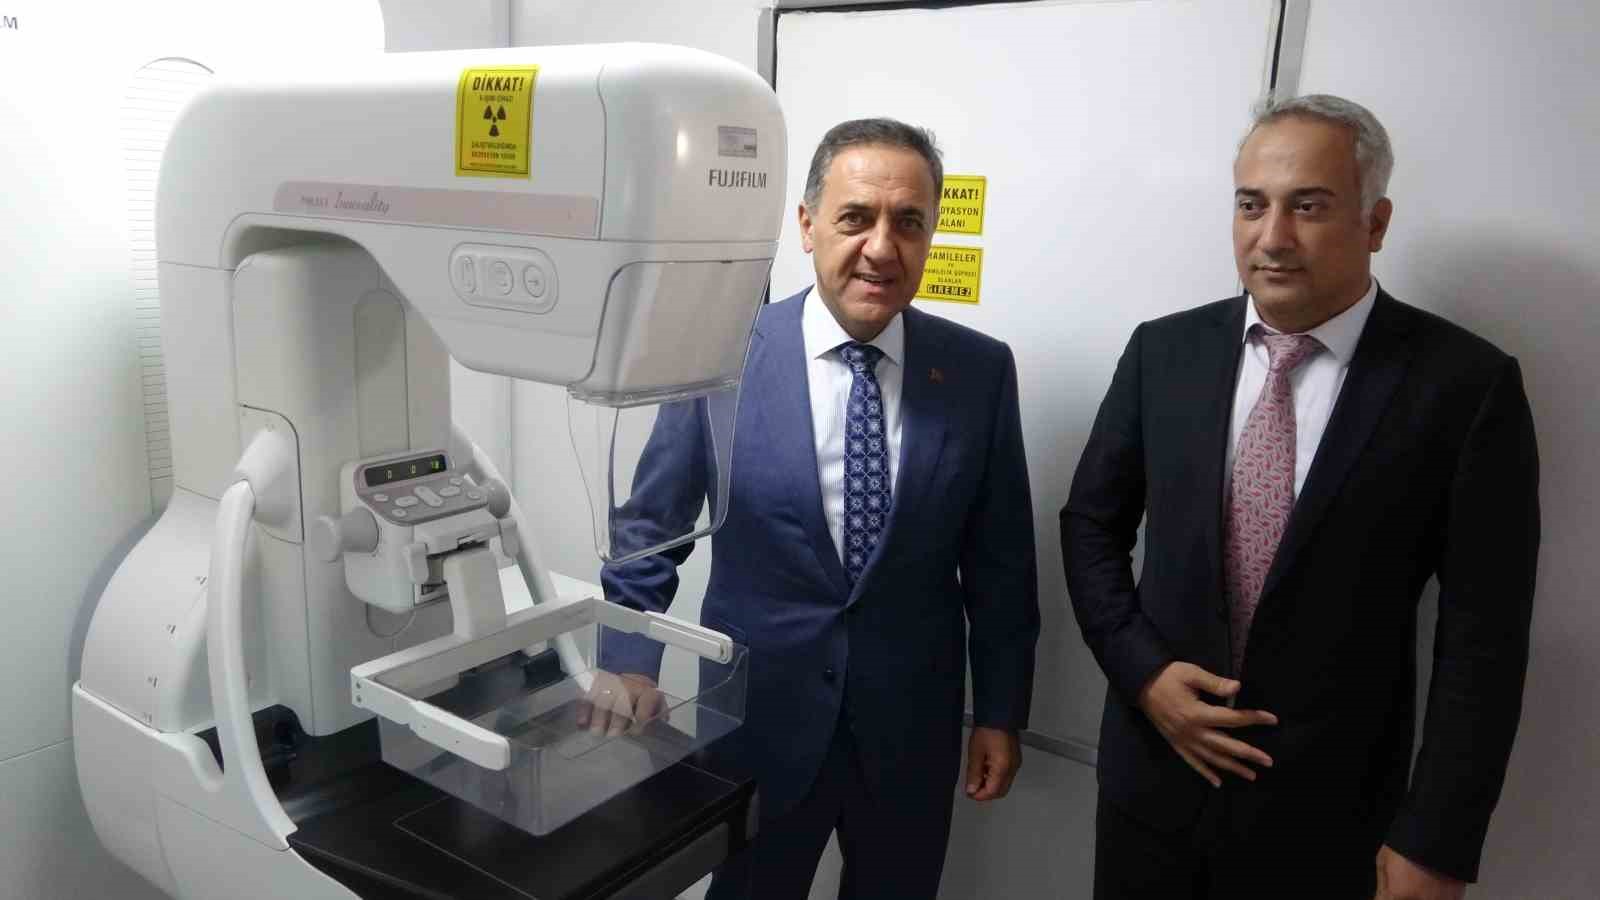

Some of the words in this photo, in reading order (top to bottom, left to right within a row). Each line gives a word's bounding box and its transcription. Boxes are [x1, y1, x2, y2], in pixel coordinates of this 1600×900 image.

[472, 73, 525, 92] DİKKAT!
[708, 169, 767, 189] FUJIFILM
[943, 188, 979, 200] KKAT!
[940, 206, 979, 217] DYASYON
[940, 218, 966, 229] ALANI
